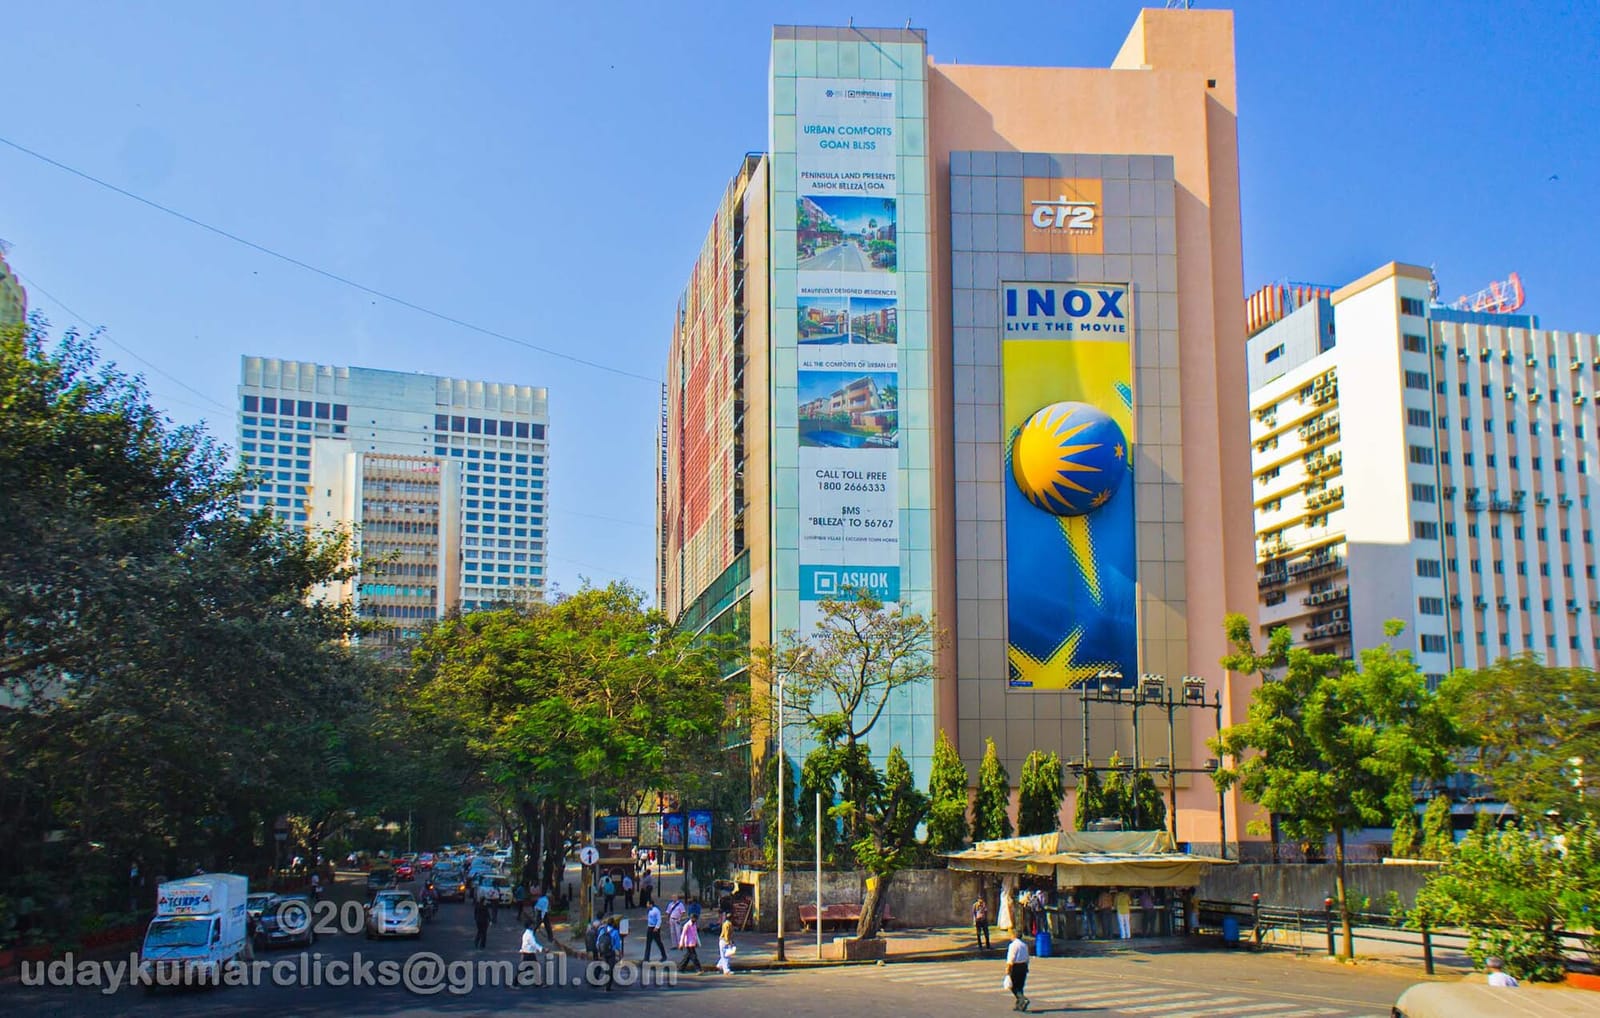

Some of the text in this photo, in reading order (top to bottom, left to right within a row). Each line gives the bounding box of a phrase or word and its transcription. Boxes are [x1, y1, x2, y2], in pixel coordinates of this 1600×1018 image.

[804, 125, 892, 136] URBAN COMFORTS
[819, 140, 876, 150] GOAN BLISS
[801, 172, 896, 181] PENINSULA LAND PRESENTS
[811, 182, 837, 190] ASHOK
[838, 182, 863, 190] BELEZA
[1006, 288, 1125, 319] INOX
[1007, 322, 1126, 333] LIVE THE MOVIE
[816, 470, 887, 480] CALL TOLL FREE
[819, 482, 886, 492] 1800 2666333
[841, 506, 861, 516] SMS
[808, 517, 894, 529] "BELEZA" TO 56767
[841, 571, 889, 589] ASHOK
